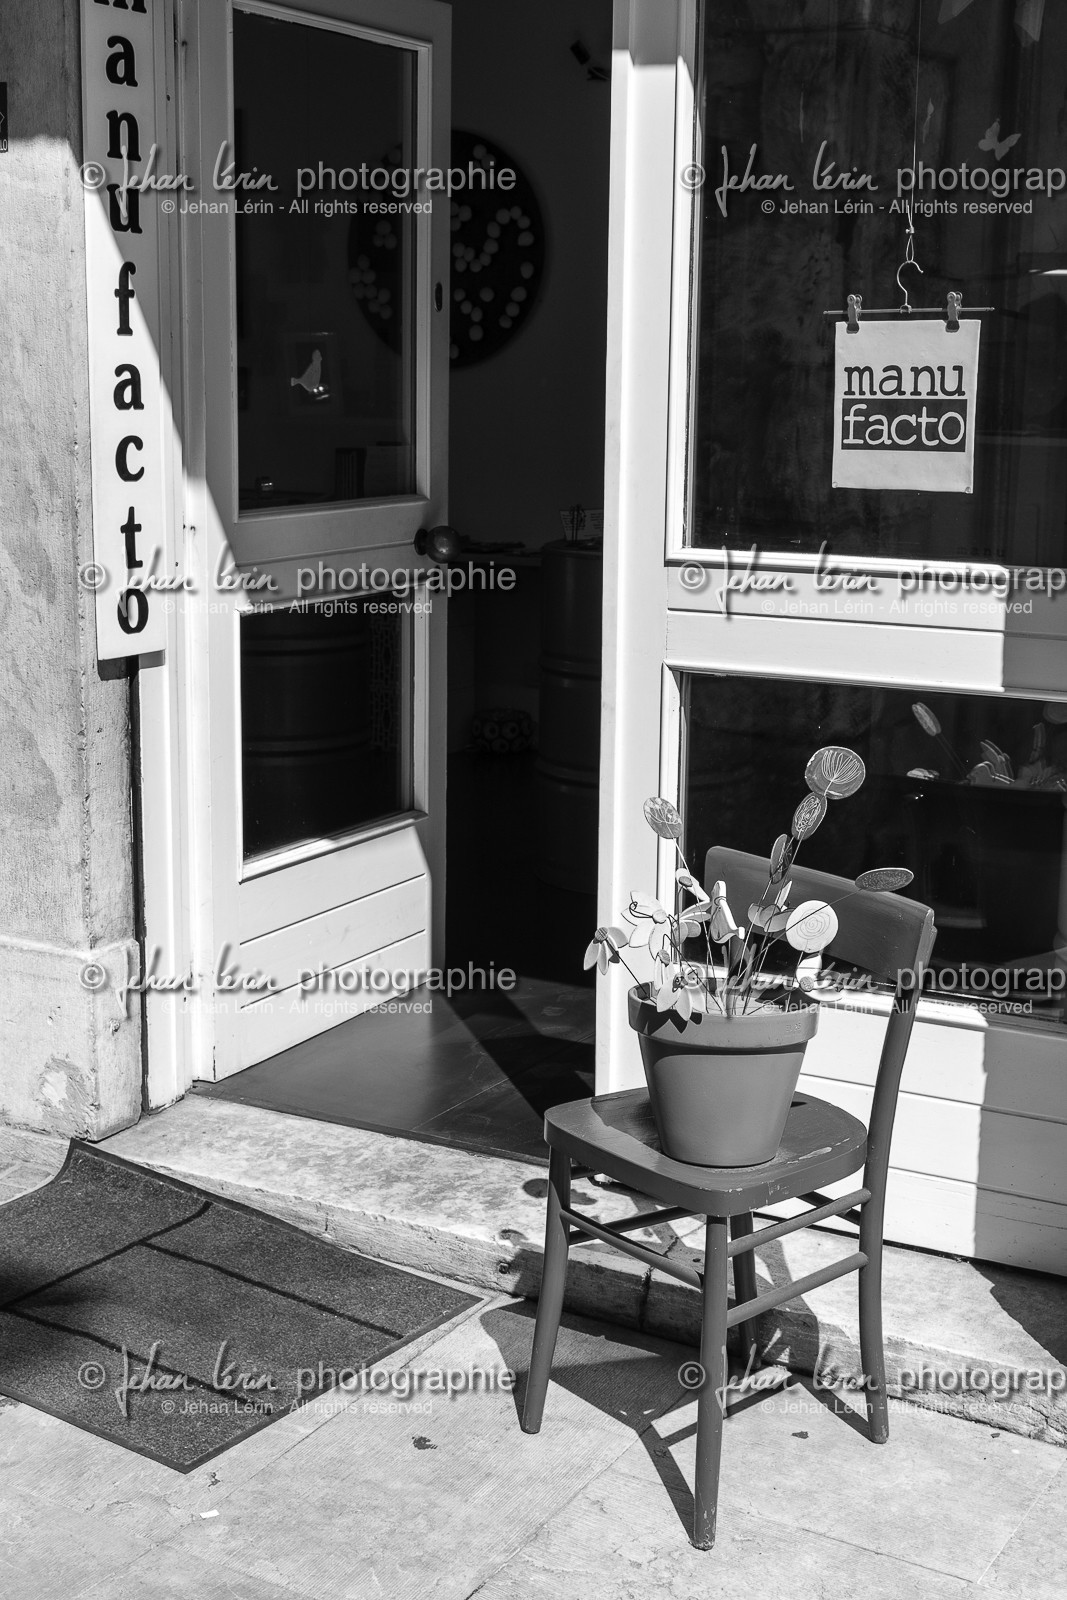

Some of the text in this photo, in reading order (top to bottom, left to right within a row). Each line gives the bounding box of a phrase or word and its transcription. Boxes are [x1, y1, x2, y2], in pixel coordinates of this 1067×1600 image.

[93, 0, 149, 634] anufacto
[843, 363, 966, 397] manu
[843, 403, 966, 447] facto
